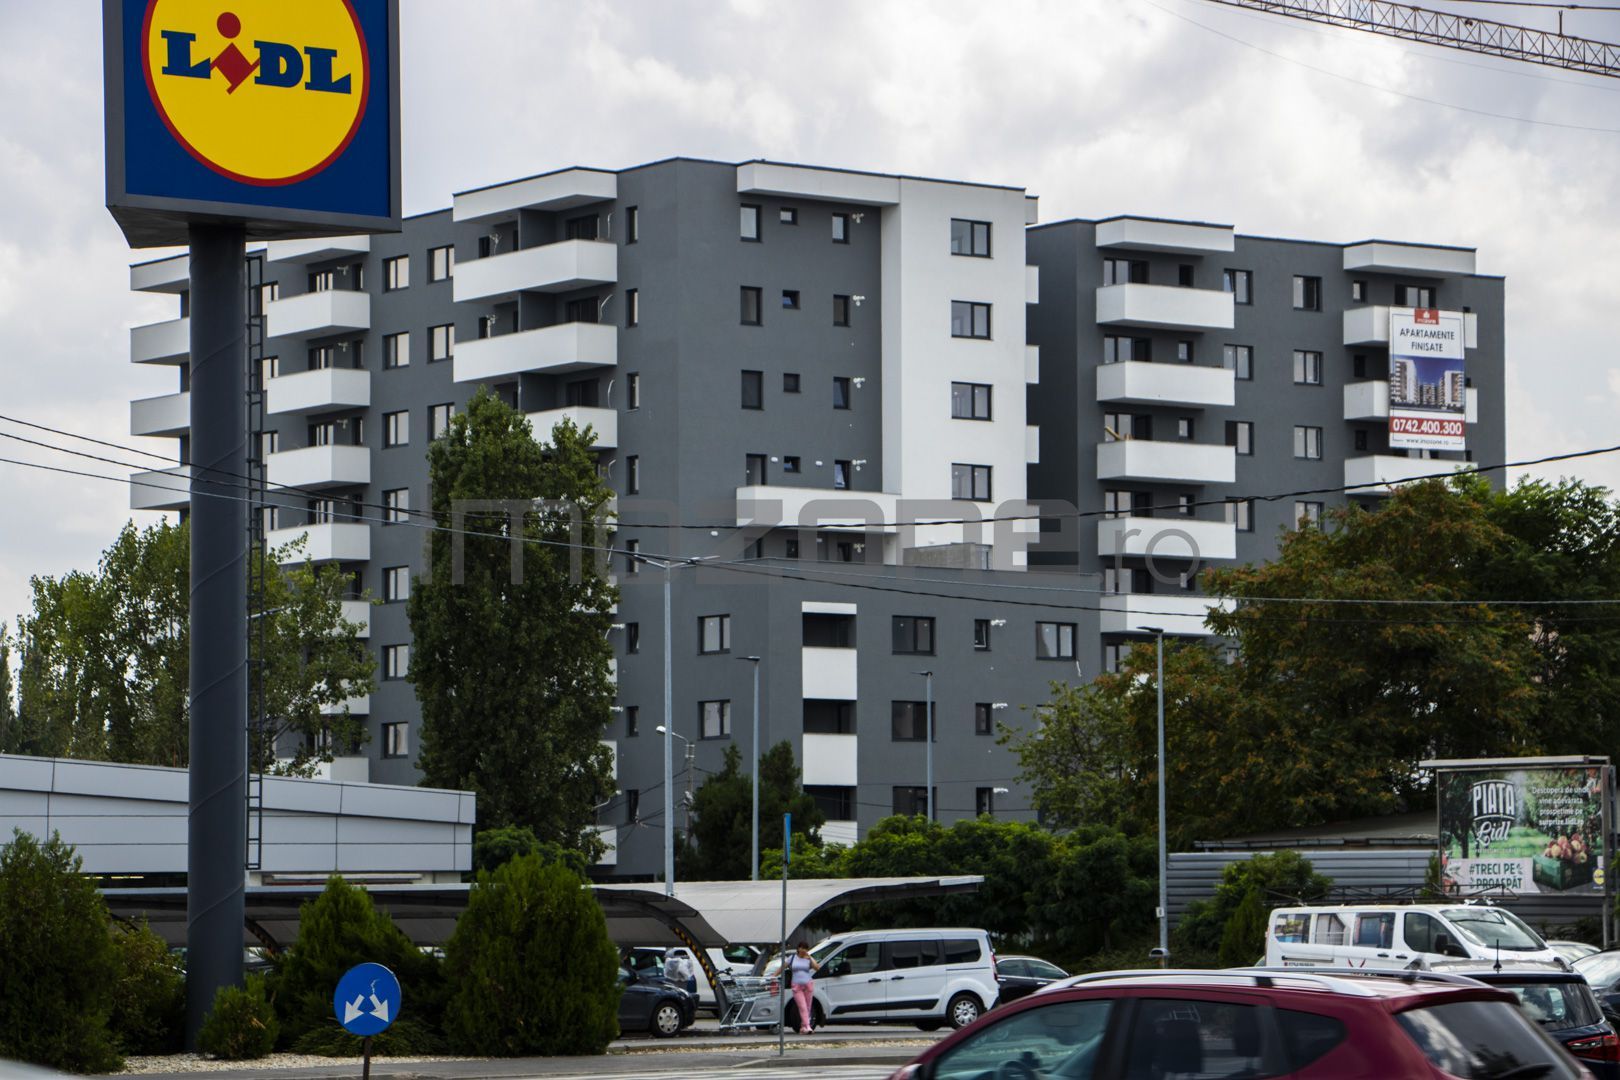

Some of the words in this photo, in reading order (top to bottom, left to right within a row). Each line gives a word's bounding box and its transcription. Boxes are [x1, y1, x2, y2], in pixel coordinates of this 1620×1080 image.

[1399, 327, 1456, 341] APARTAMENTE
[1411, 341, 1444, 352] FINISATE
[1392, 419, 1463, 436] 0742.400.300
[1475, 821, 1511, 847] Lidl
[1469, 863, 1501, 875] #TRECI
[1503, 863, 1516, 875] PE
